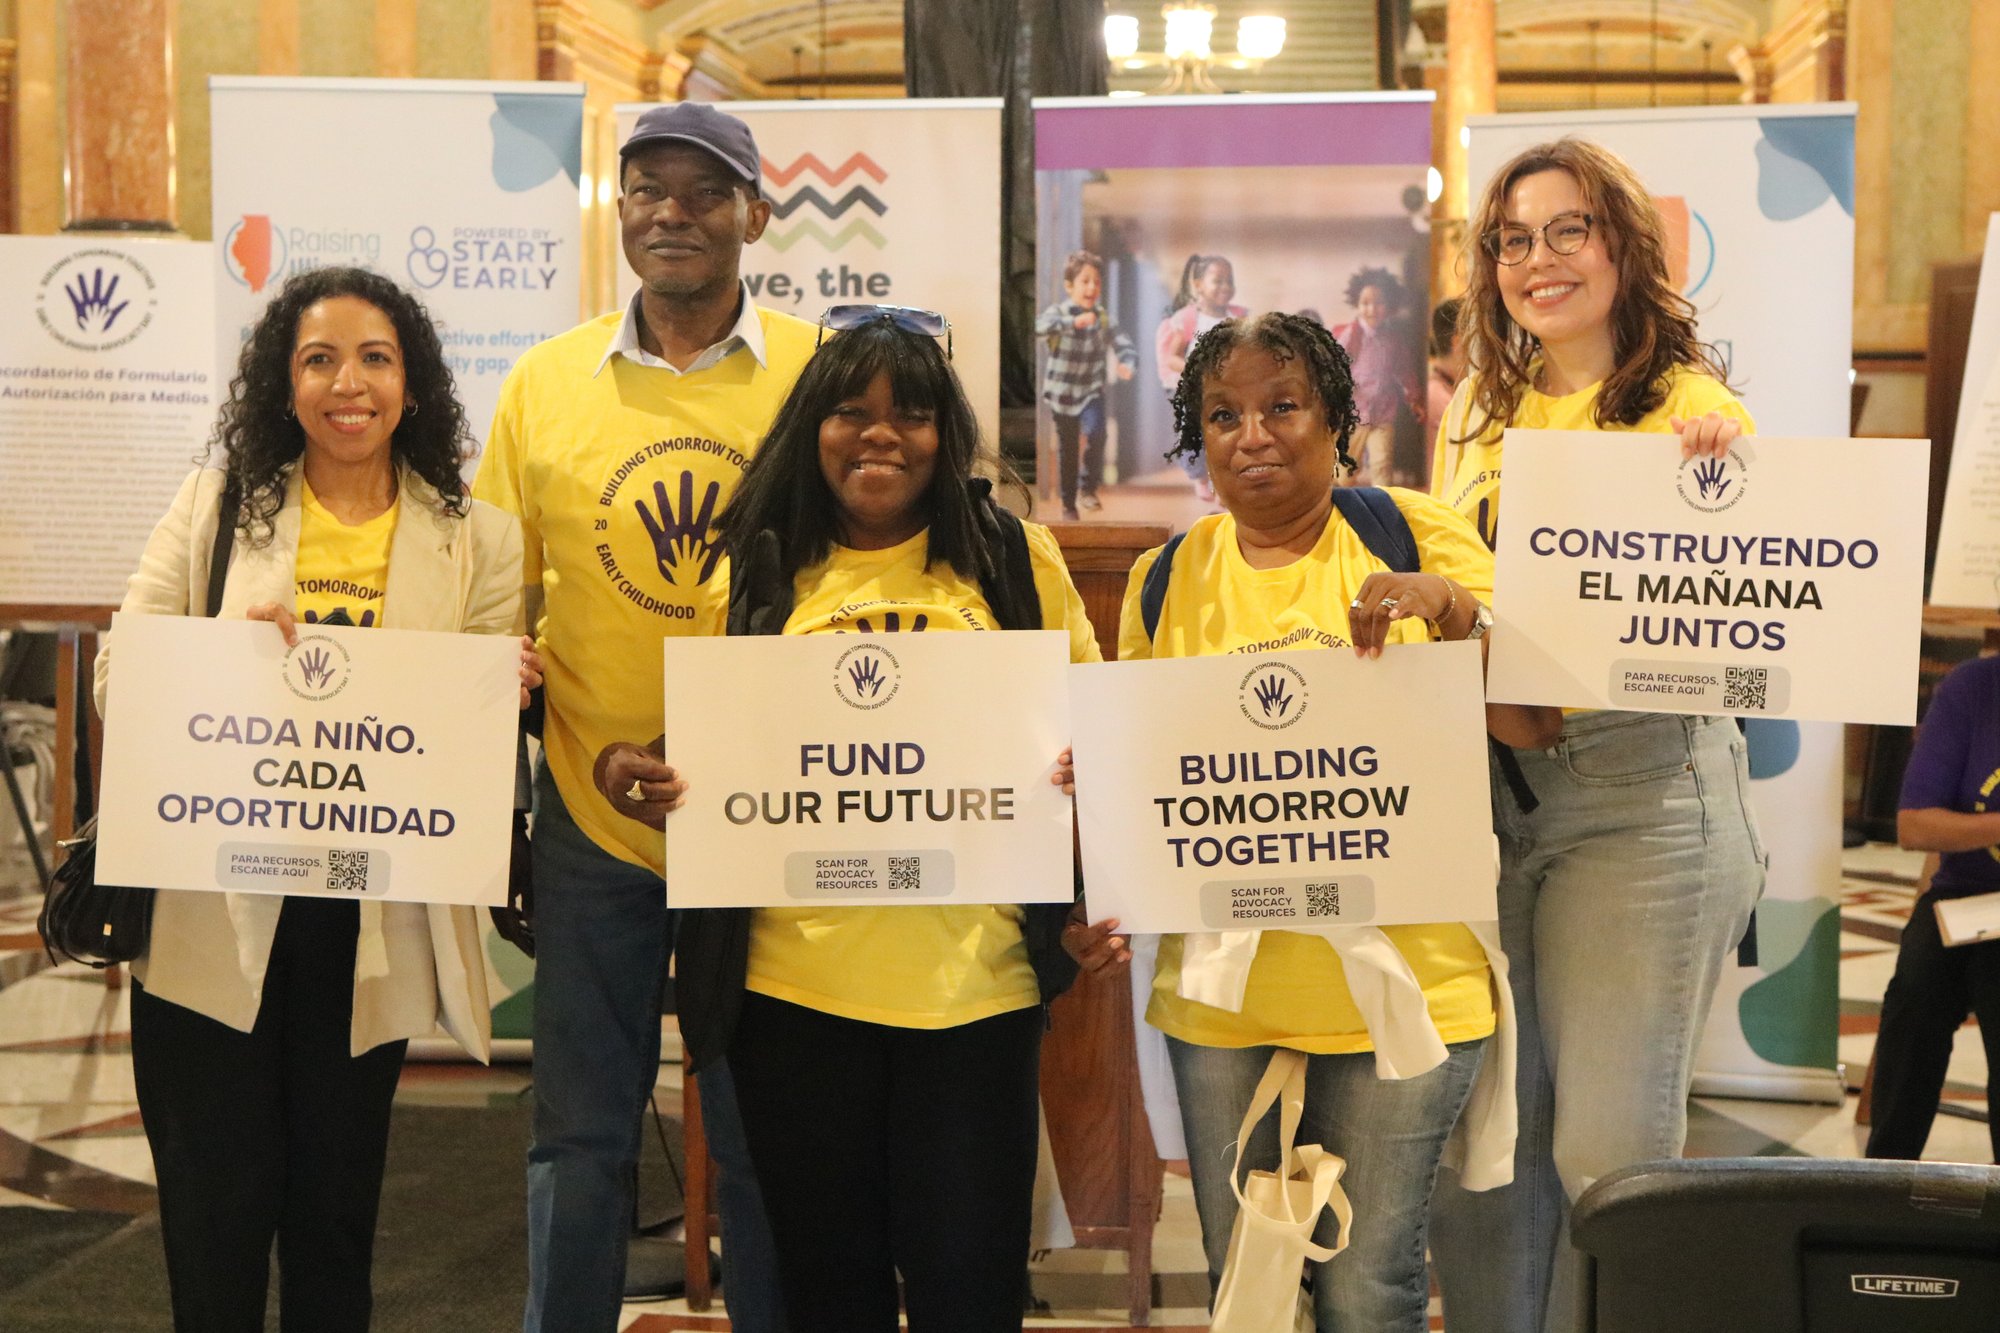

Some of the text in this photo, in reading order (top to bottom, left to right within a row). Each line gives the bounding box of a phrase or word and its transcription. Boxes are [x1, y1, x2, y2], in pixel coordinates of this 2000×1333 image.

[290, 227, 381, 260] Raising
[453, 227, 550, 239] POWERED BY
[453, 240, 557, 262] START
[453, 267, 556, 289] EARLY
[816, 264, 891, 298] the
[489, 329, 534, 346] effort
[94, 368, 114, 381] de
[118, 370, 208, 383] Formulario
[2, 386, 209, 405] Autorización para Medios
[599, 437, 727, 507] BUILDING TOMORROW
[594, 519, 608, 530] 20
[1530, 527, 1878, 569] CONSTRUYENDO
[596, 543, 696, 620] EARLY CHILDHOOD
[1579, 570, 1824, 610] EL MAÑANA
[1237, 627, 1314, 654] TOMORROW
[1619, 615, 1787, 651] JUNTOS
[835, 643, 900, 670] BUILDING TOMORROW TOGETHER
[1240, 661, 1307, 690] BUILDING TOMORROW TOGETHER
[1625, 672, 1719, 686] PARA RECURSOS,
[1624, 683, 1705, 695] ESCANEE AQUÍ
[871, 693, 894, 710] ADVOCACY
[1249, 717, 1279, 730] CHILDHOOD
[1279, 711, 1302, 729] ADVOCACY
[187, 713, 424, 755] CADA NIÑO.
[800, 742, 925, 777] FUND
[1180, 745, 1379, 785] BUILDING
[253, 757, 366, 792] CADA
[157, 793, 456, 837] OPORTUNIDAD
[724, 787, 1015, 825] OUR FUTURE
[1154, 786, 1410, 827] TOMORROW
[1167, 828, 1390, 867] TOGETHER
[230, 865, 279, 876] ESCANEE
[231, 854, 323, 868] PARA RECURSOS,
[816, 859, 868, 868] SCAN FOR
[816, 869, 875, 879] ADVOCACY
[816, 880, 878, 890] RESOURCES
[1231, 887, 1285, 897] SCAN FOR
[1232, 897, 1292, 908] ADVOCACY
[1233, 908, 1296, 918] RESOURCES
[1864, 1278, 1946, 1293] LIFETIME
